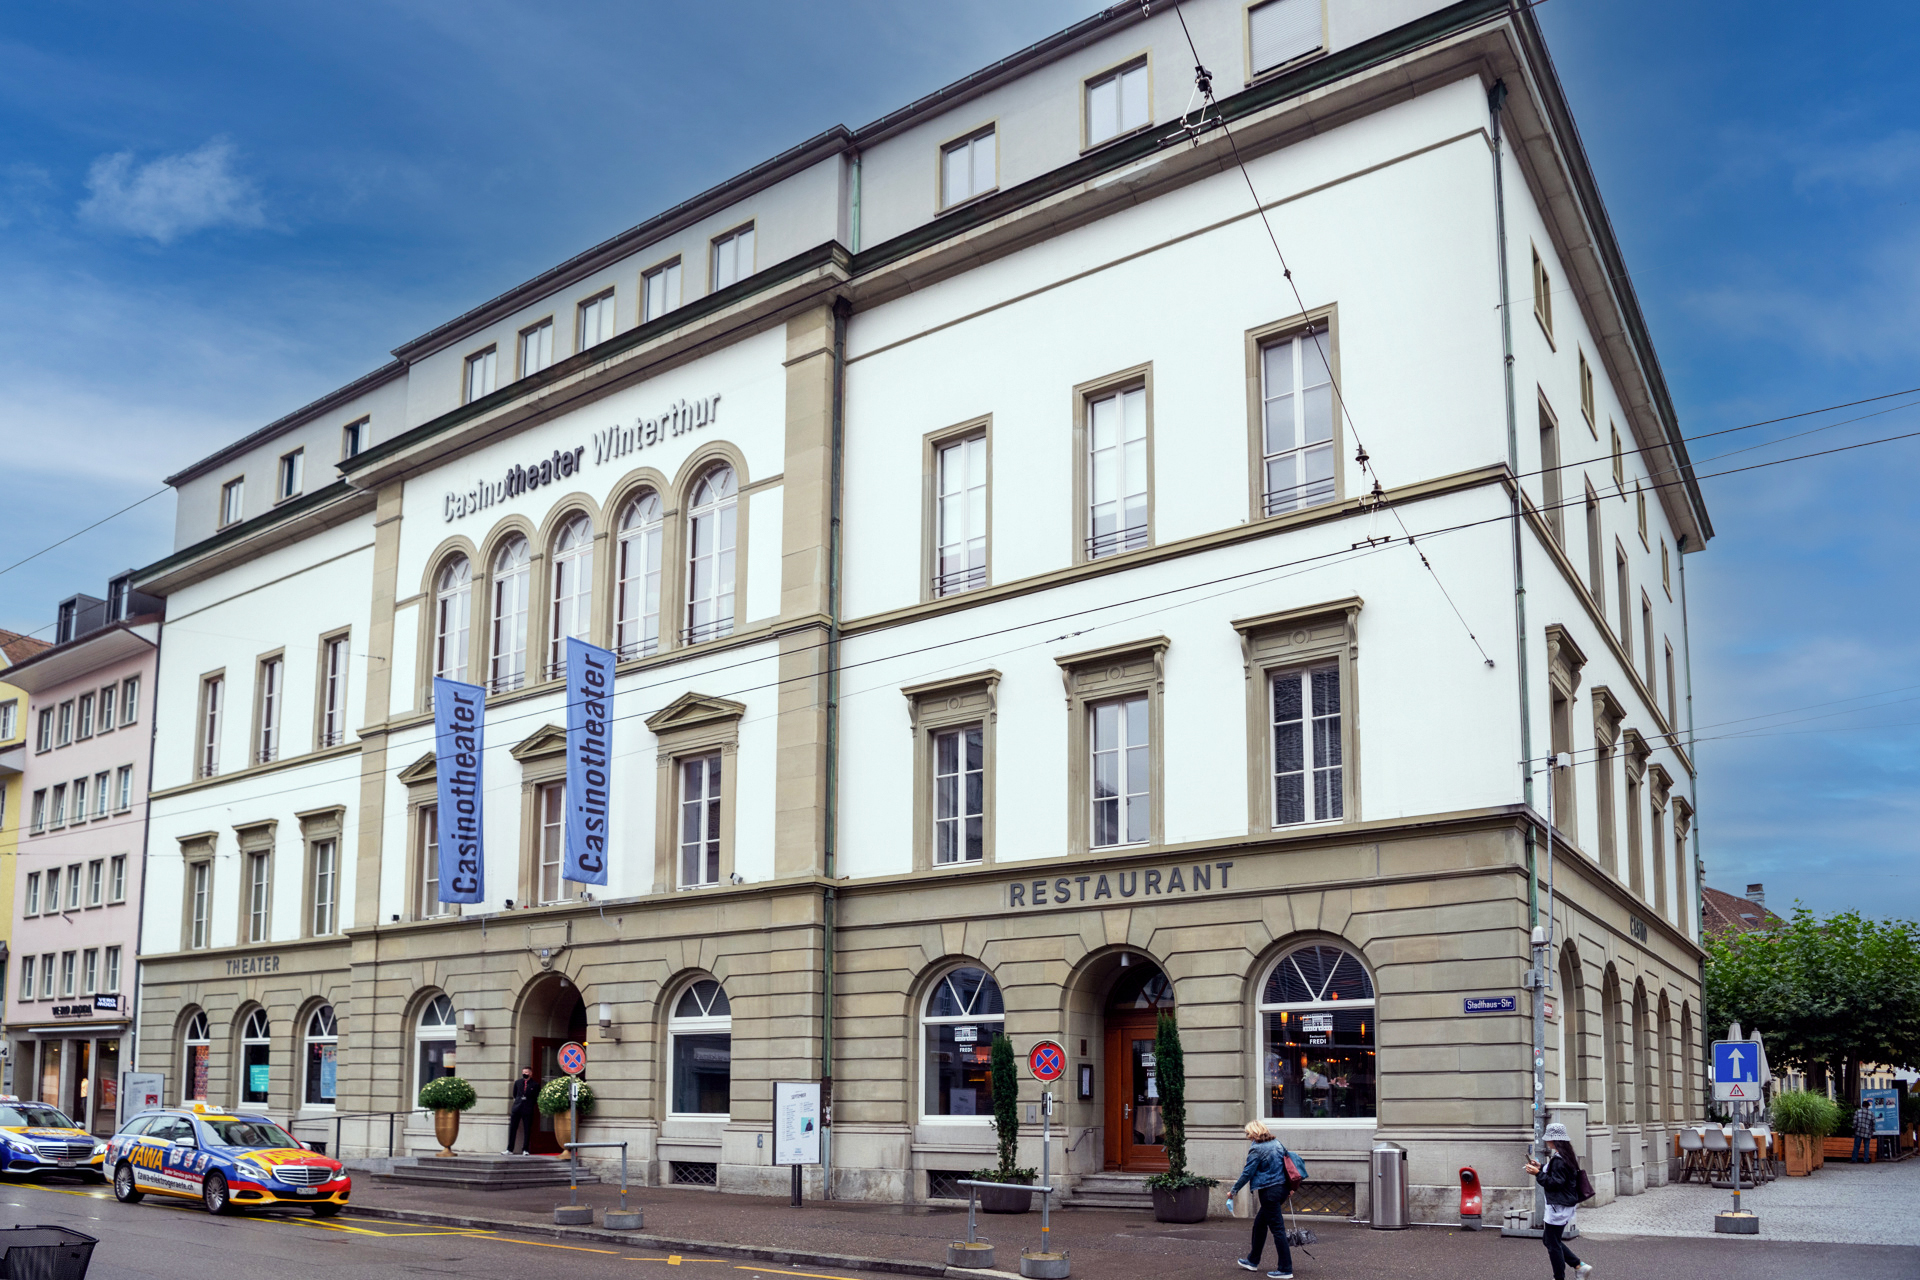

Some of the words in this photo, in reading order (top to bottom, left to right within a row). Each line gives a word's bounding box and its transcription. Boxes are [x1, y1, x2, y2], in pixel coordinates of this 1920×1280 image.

[444, 445, 585, 522] Casinotheater
[591, 393, 721, 465] Winterthur
[578, 652, 607, 873] Casinotheater
[449, 691, 478, 894] Casinotheater
[1010, 862, 1233, 907] RESTAURANT
[226, 955, 280, 975] THEATER
[1467, 998, 1513, 1010] Stadthaus-Str.
[137, 1171, 194, 1190] tawa-elektrogeraete.ch
